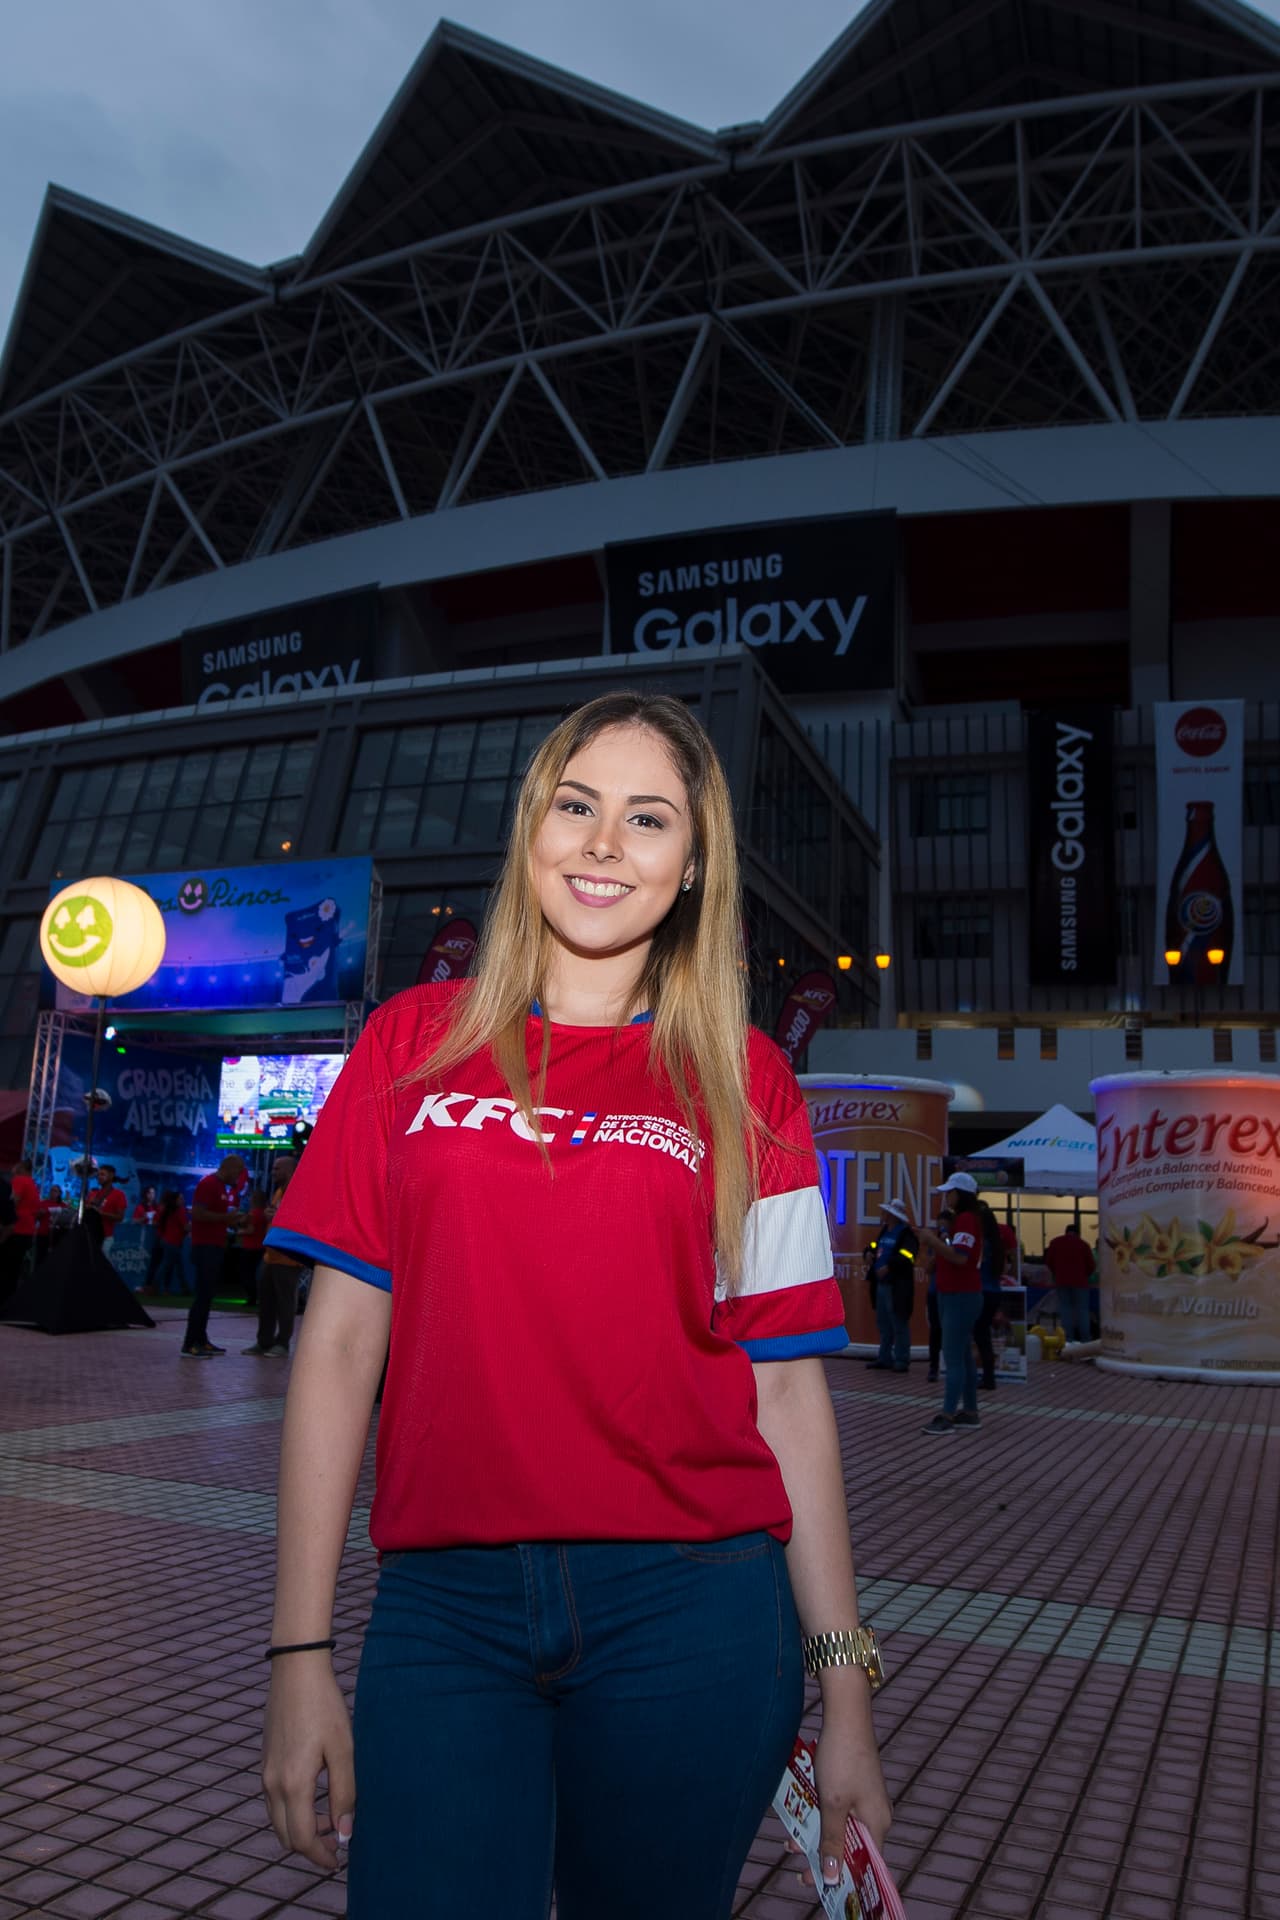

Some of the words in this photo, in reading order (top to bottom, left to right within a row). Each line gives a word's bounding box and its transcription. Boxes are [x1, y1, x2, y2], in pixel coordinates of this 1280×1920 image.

[638, 553, 784, 597] SAMSUNG
[632, 594, 870, 657] Galaxy
[202, 631, 303, 675] SAMSUNG
[1050, 721, 1095, 871] Galaxy
[206, 878, 290, 908] Pinos
[1060, 876, 1078, 971] SAMSUNG
[803, 989, 829, 1002] KFC
[405, 1092, 566, 1143] KFC
[600, 1121, 619, 1129] DE
[605, 1114, 678, 1129] PATROCINADOR
[809, 1099, 904, 1126] nterex
[593, 1129, 699, 1174] NACIONAL
[1162, 1160, 1220, 1175] Balanced
[1222, 1161, 1272, 1178] Nutrition
[1145, 1179, 1203, 1194] Completa
[1206, 1180, 1215, 1192] y
